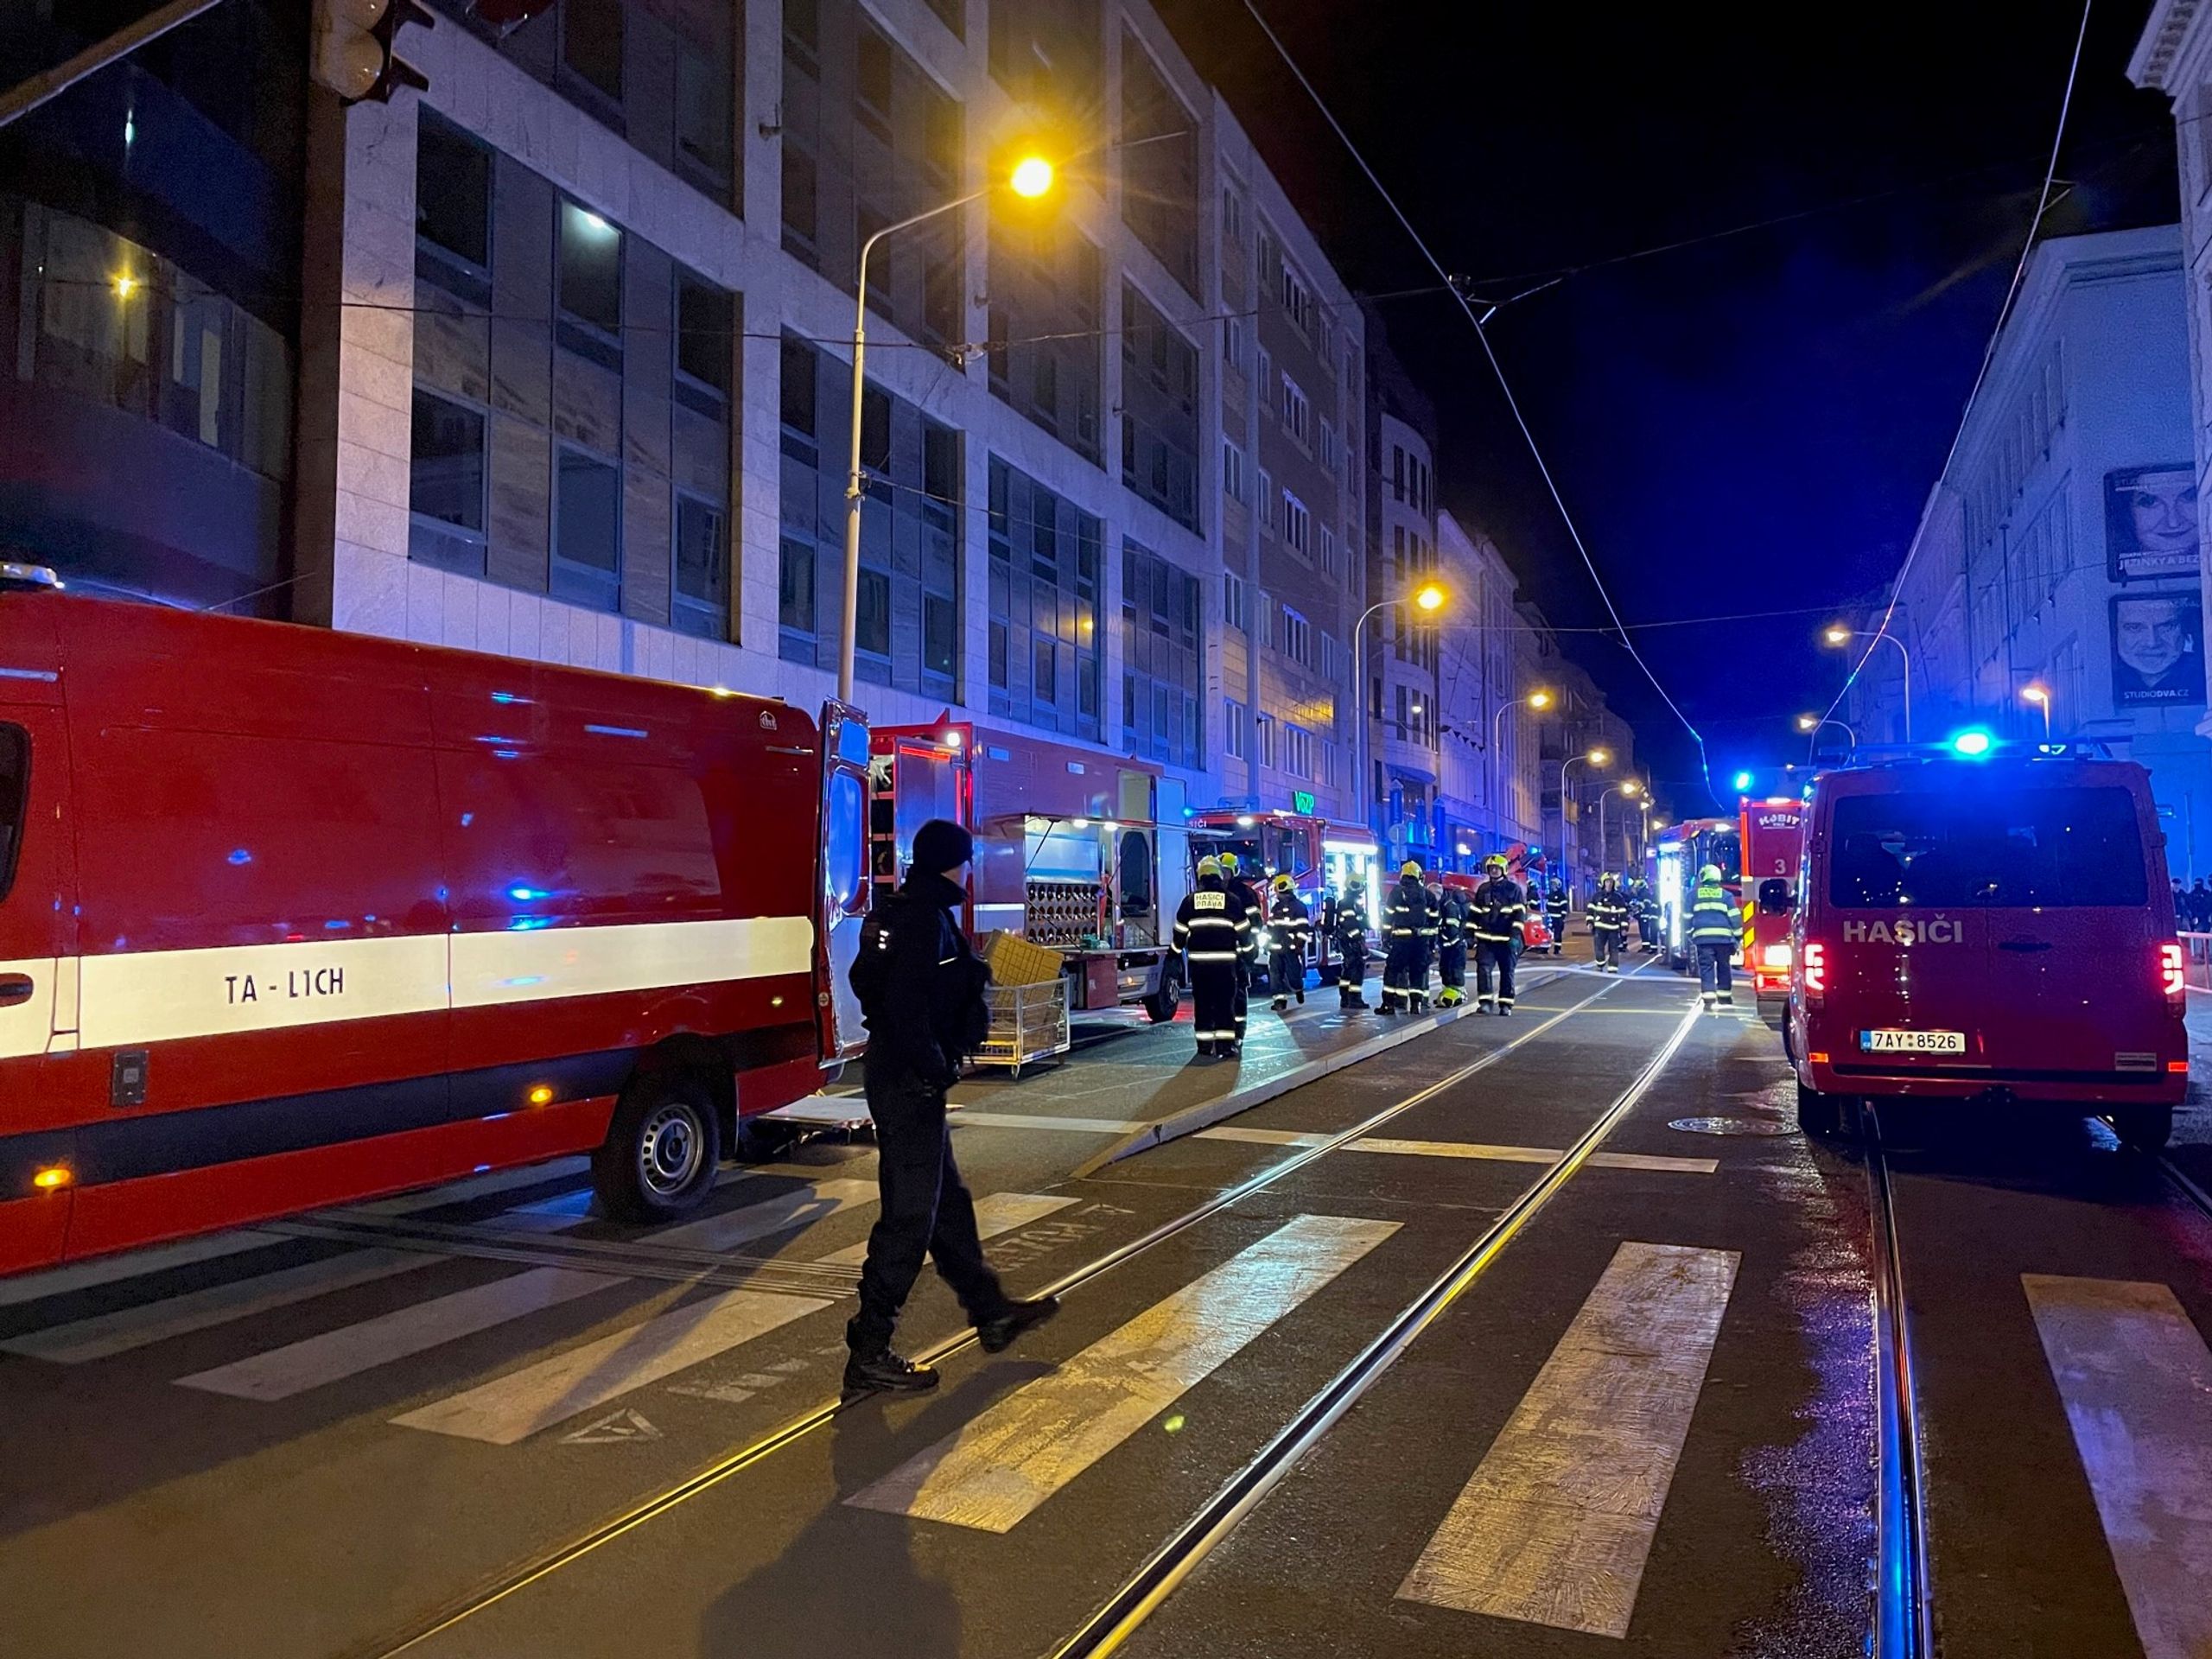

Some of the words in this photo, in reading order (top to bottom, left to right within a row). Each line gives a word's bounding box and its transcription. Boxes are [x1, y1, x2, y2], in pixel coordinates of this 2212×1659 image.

[2124, 689, 2190, 699] STUDIODVA.CZ
[1775, 859, 1786, 874] 3
[1843, 912, 1963, 944] HASIČI
[225, 974, 257, 1004] TA
[1874, 1033, 1904, 1048] 7AY
[1916, 1034, 1956, 1049] 8526
